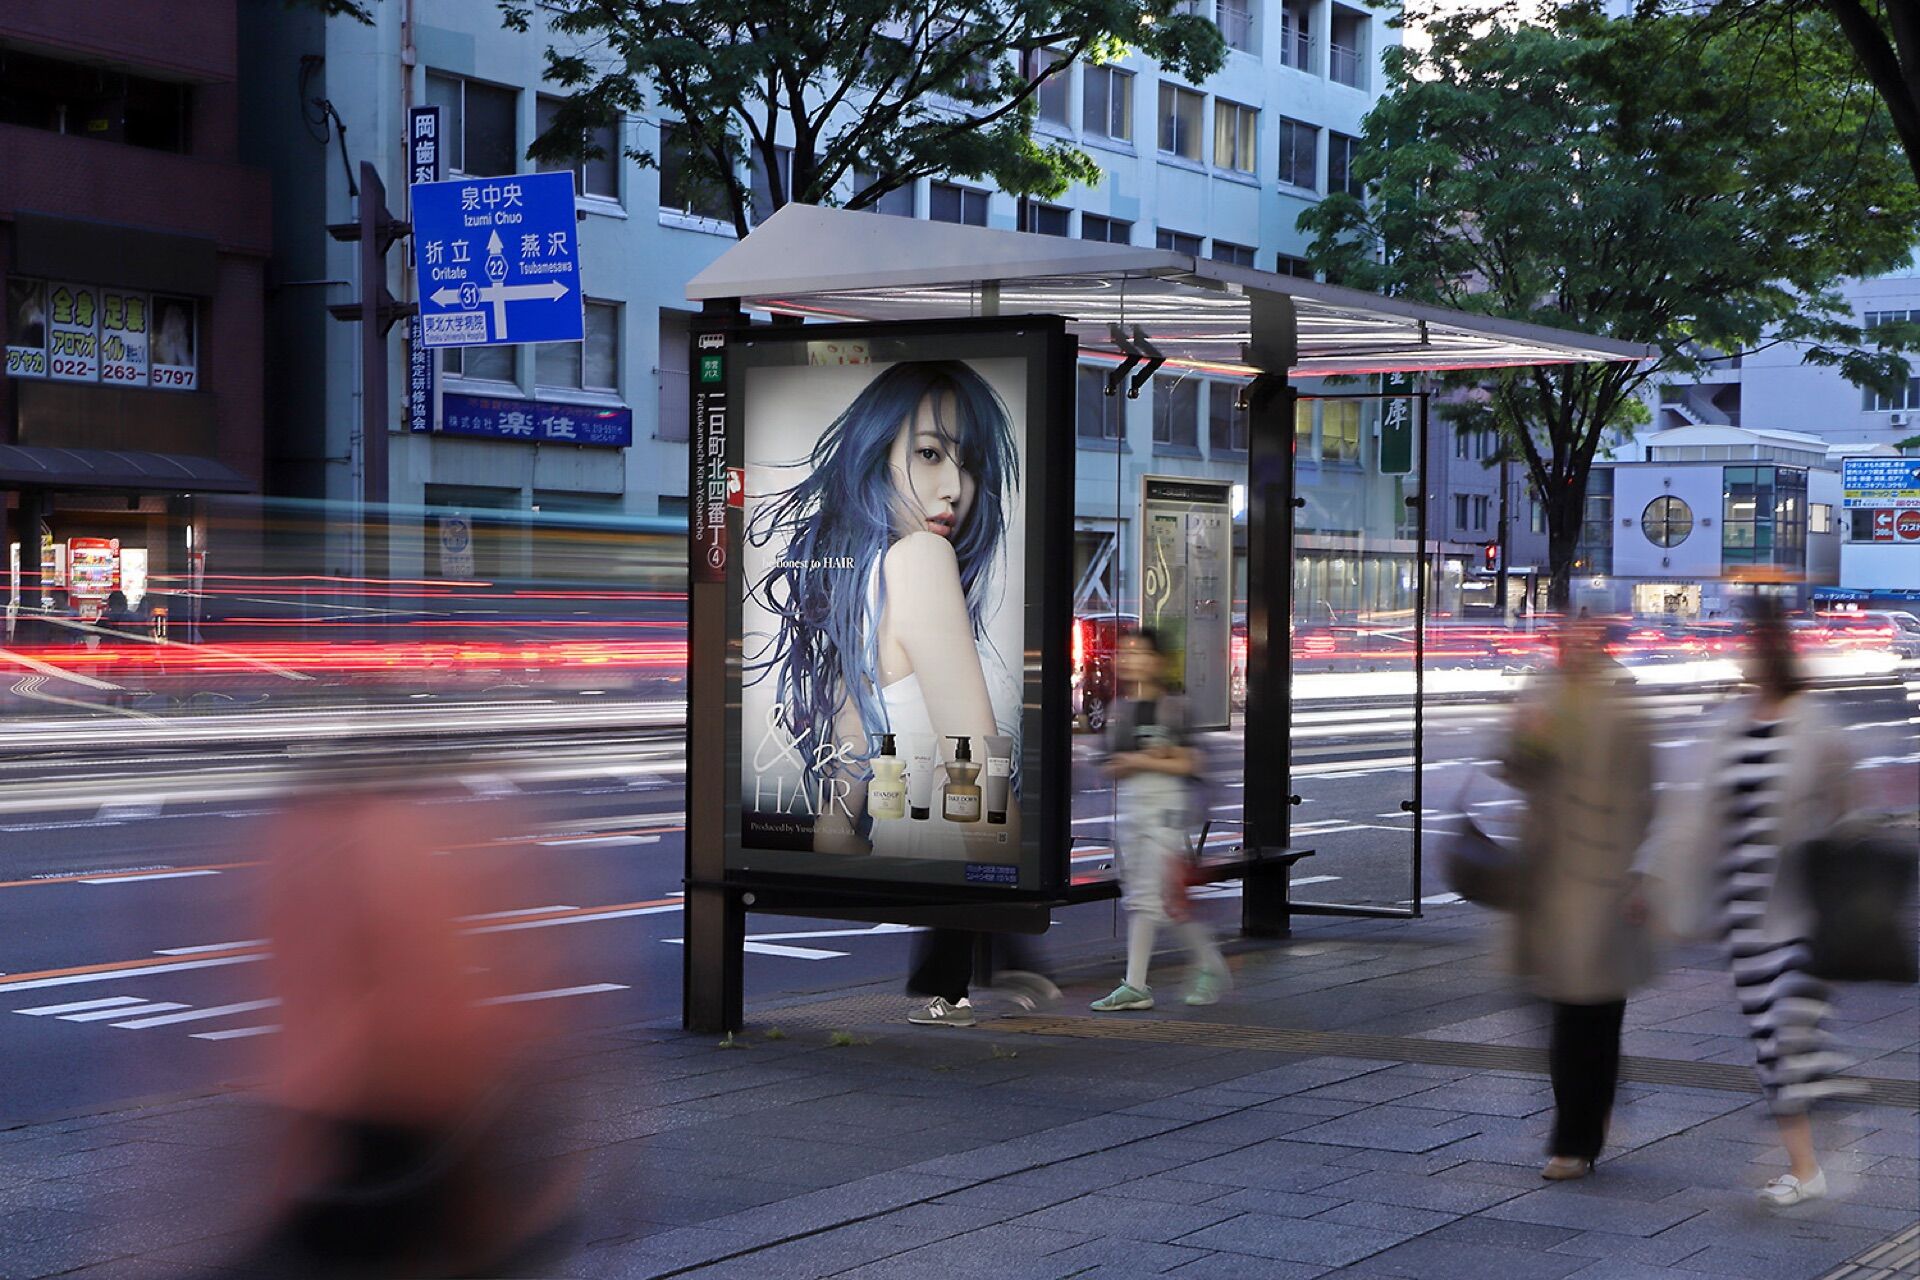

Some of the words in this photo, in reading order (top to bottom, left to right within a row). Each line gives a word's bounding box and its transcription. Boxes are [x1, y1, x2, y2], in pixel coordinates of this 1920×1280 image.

[416, 114, 435, 184] 岡歯科
[461, 183, 523, 211] 泉中央
[464, 213, 492, 227] Izumi
[494, 211, 523, 225] Chuo
[425, 239, 471, 265] 折立
[520, 232, 568, 258] 燕沢
[431, 266, 467, 281] Oritate
[489, 260, 504, 276] 22
[519, 261, 573, 275] Tsubamesawa
[462, 287, 477, 304] 31
[52, 286, 96, 328] 全身
[104, 293, 146, 334] 足裏
[425, 314, 485, 332] 東北大学病院
[6, 349, 44, 374] ワヤカ
[448, 415, 493, 431] 株式会社
[707, 392, 727, 546] 二日町北四番丁
[823, 557, 855, 569] HAIR
[812, 719, 858, 773] be
[753, 775, 855, 819] HAIR
[750, 822, 785, 832] Produced
